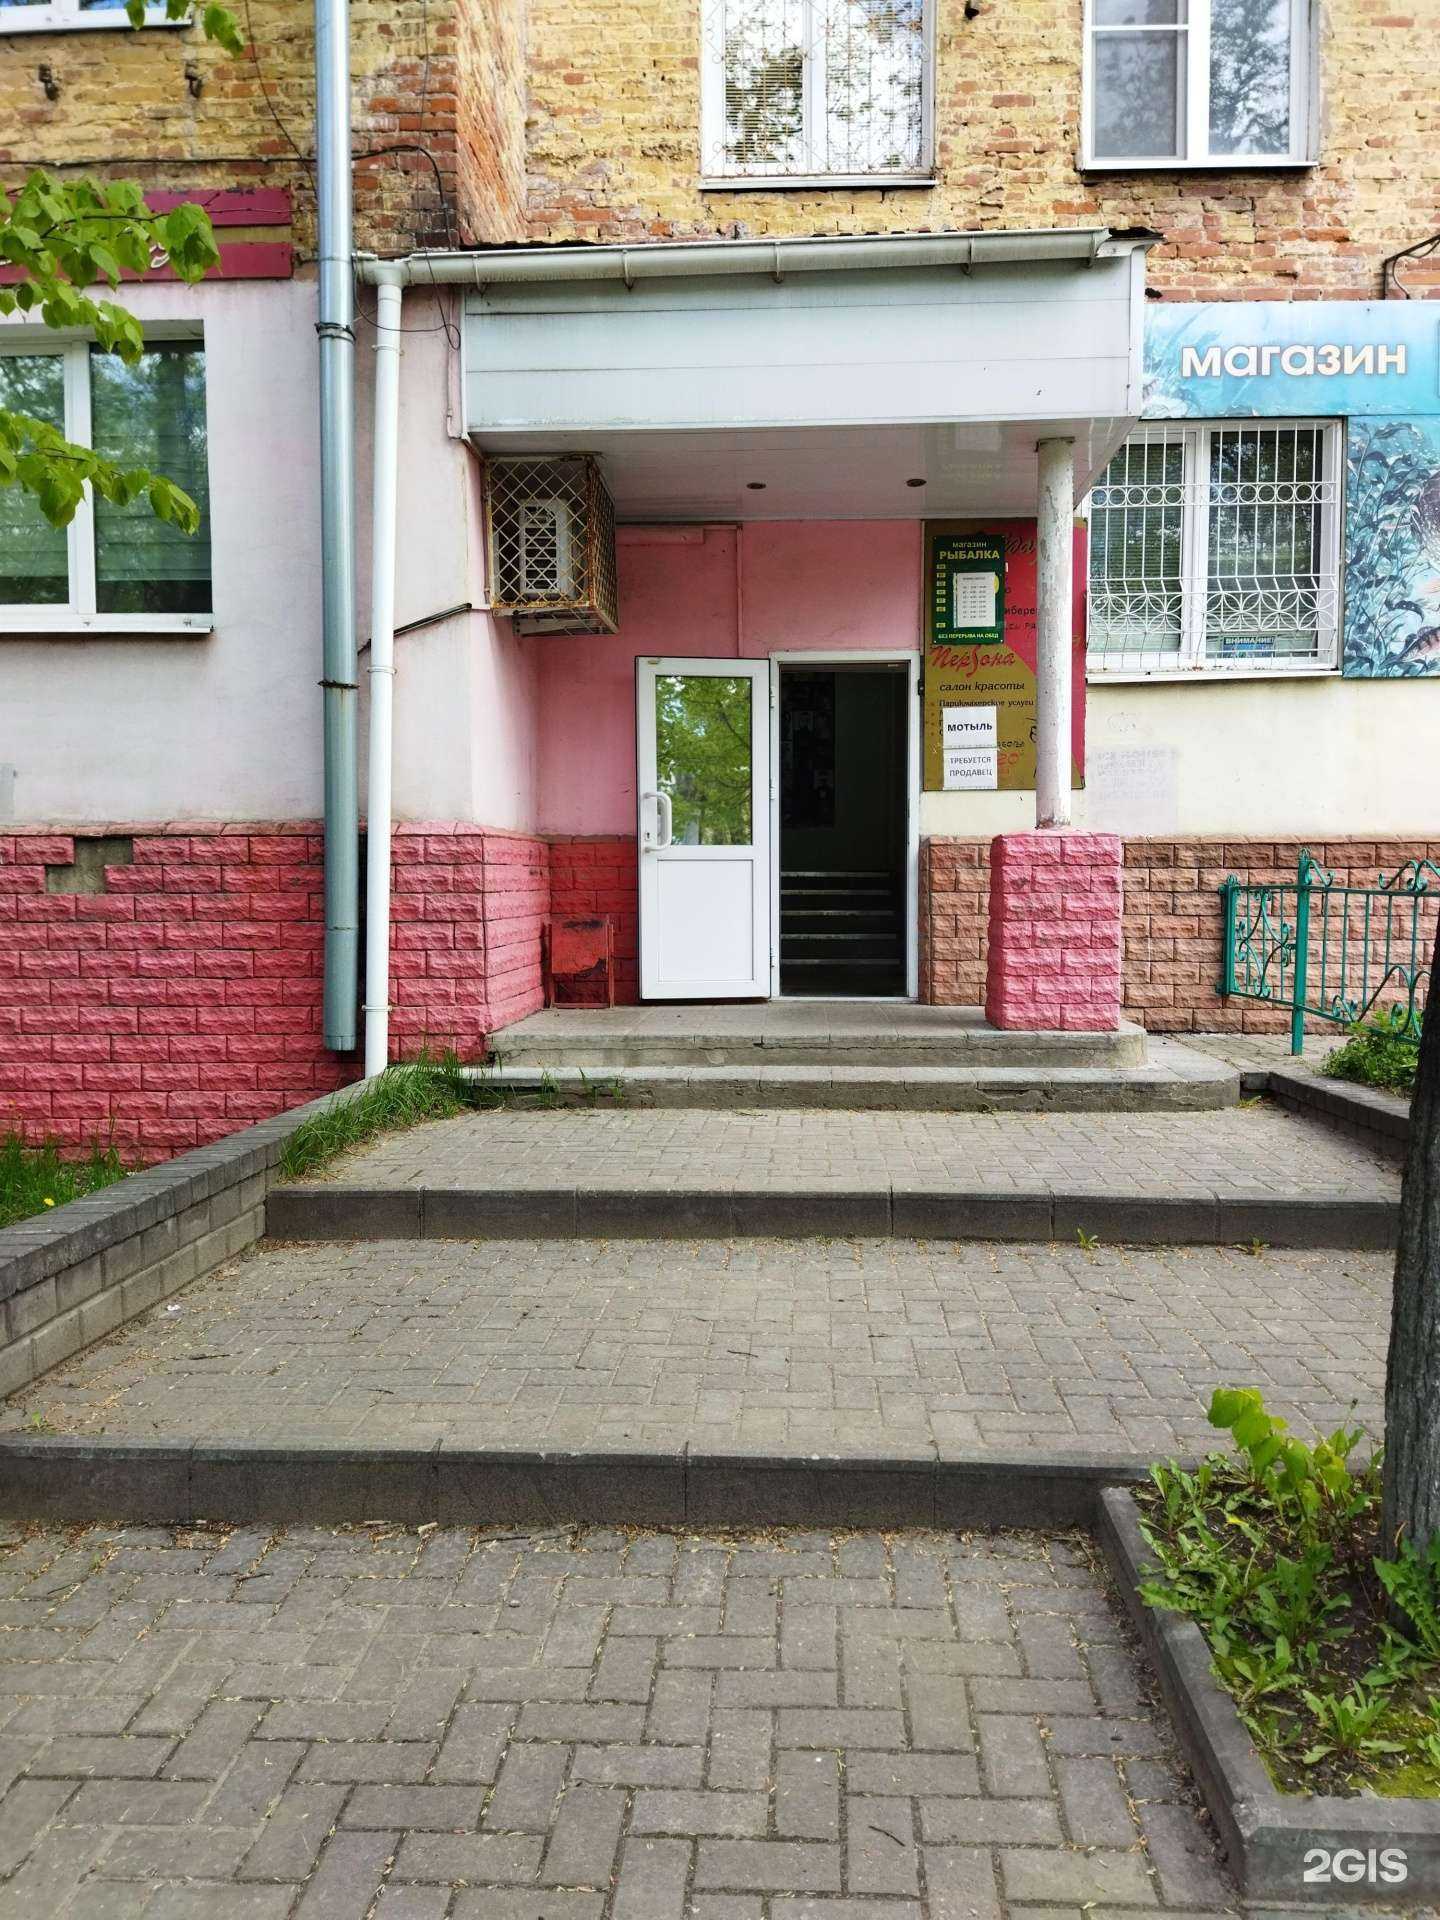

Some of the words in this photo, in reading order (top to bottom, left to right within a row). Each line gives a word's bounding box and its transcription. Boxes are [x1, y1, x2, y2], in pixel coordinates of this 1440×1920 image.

[1180, 343, 1408, 378] магазин
[939, 550, 1000, 560] РЫБАЛКА
[939, 683, 972, 692] салон
[974, 681, 1025, 694] красоты
[950, 756, 992, 764] ТРЕБУЕТСЯ
[949, 769, 993, 777] ПРОДАВЕЦ
